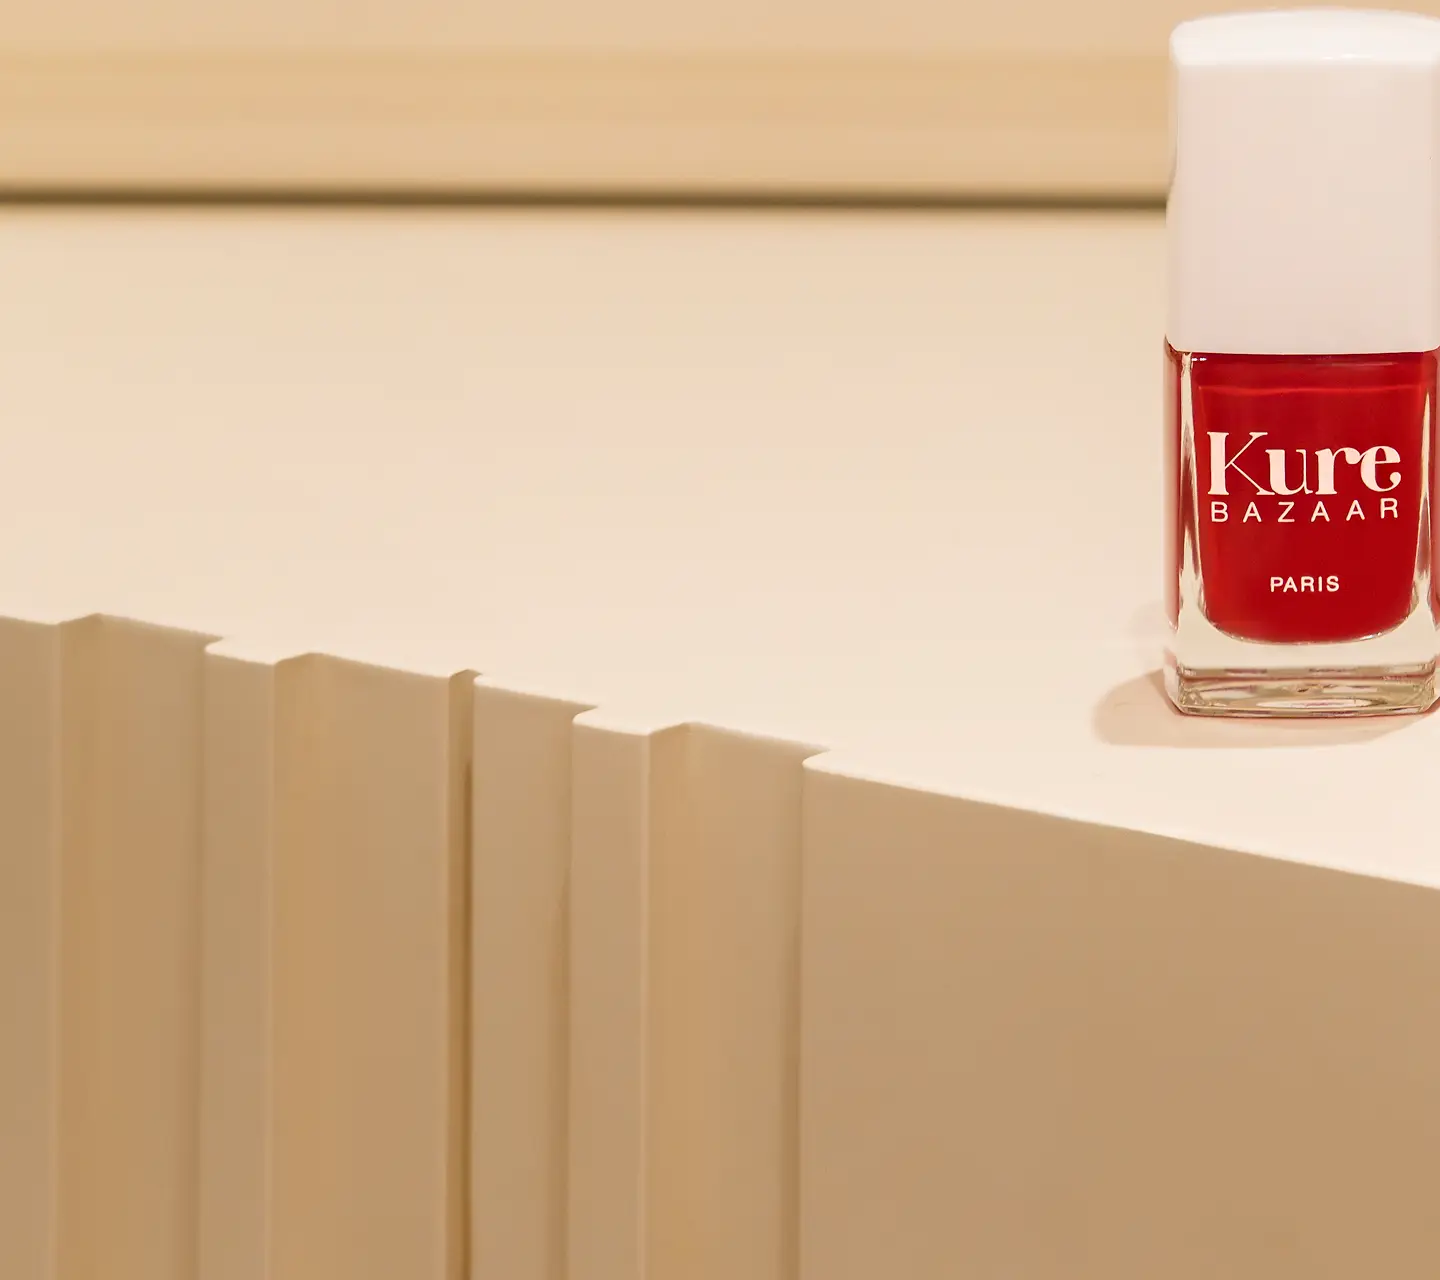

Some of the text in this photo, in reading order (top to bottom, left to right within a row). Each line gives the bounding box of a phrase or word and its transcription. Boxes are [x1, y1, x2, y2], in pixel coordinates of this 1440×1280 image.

[1206, 431, 1402, 496] Kure
[1210, 497, 1399, 523] BAZAAR
[1270, 575, 1340, 593] PARIS
